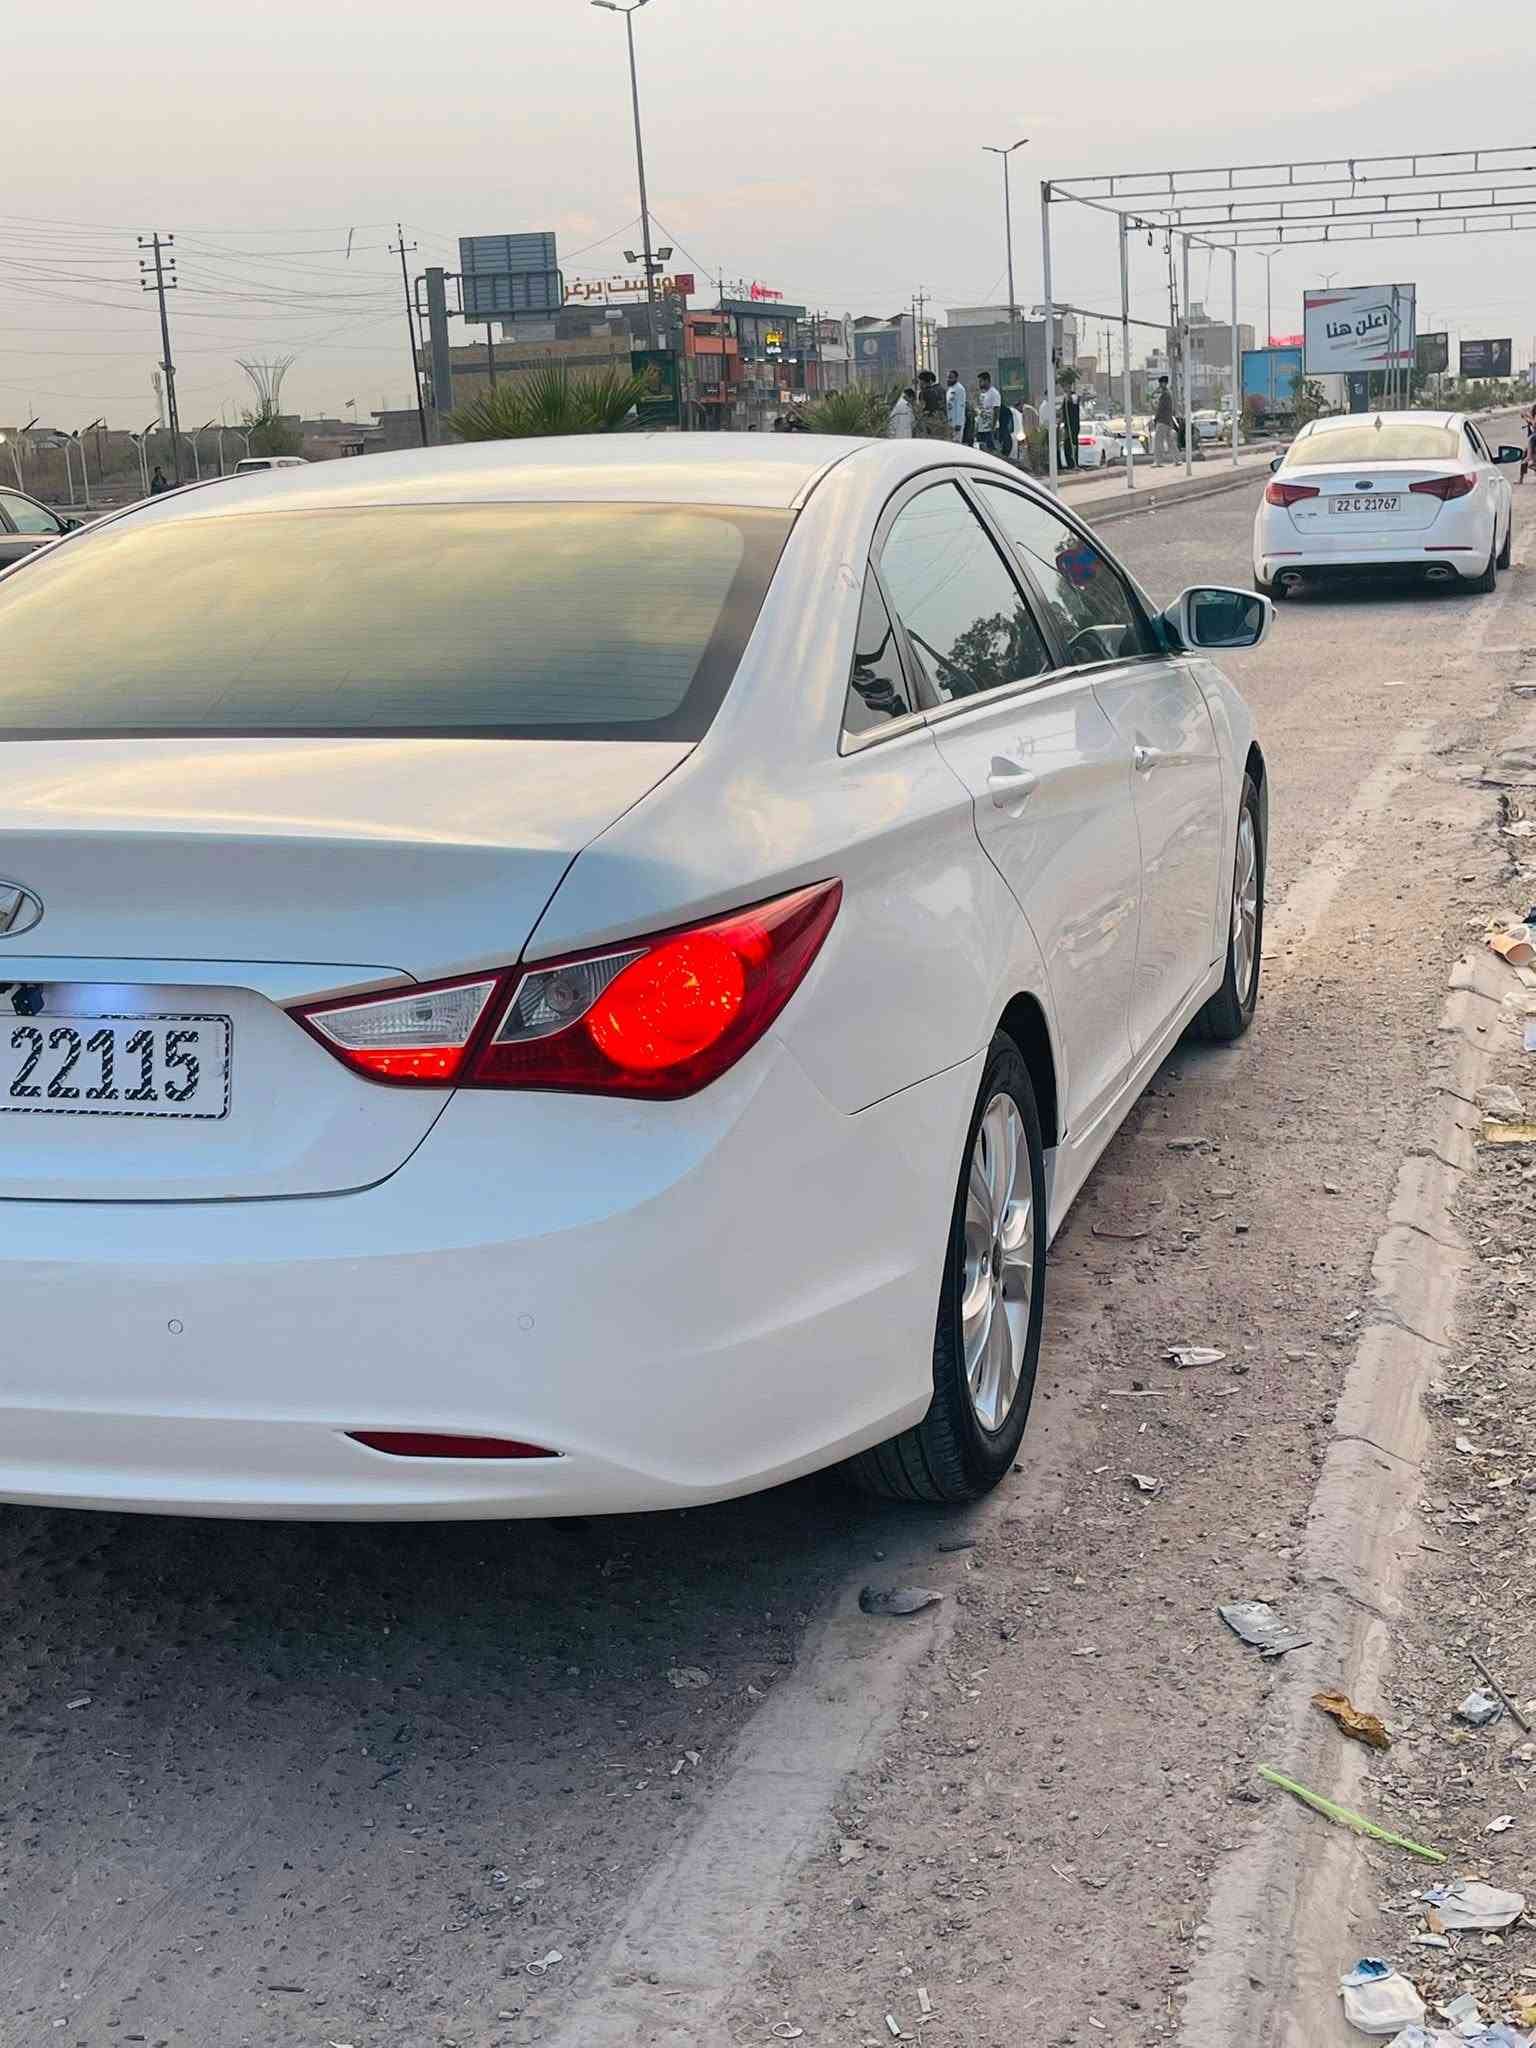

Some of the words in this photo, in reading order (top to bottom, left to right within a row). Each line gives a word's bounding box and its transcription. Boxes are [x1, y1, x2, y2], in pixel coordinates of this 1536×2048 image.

[564, 276, 602, 301] برغر
[1326, 321, 1352, 338] هنا
[1336, 500, 1350, 512] 22
[9, 1025, 200, 1101] 22115
